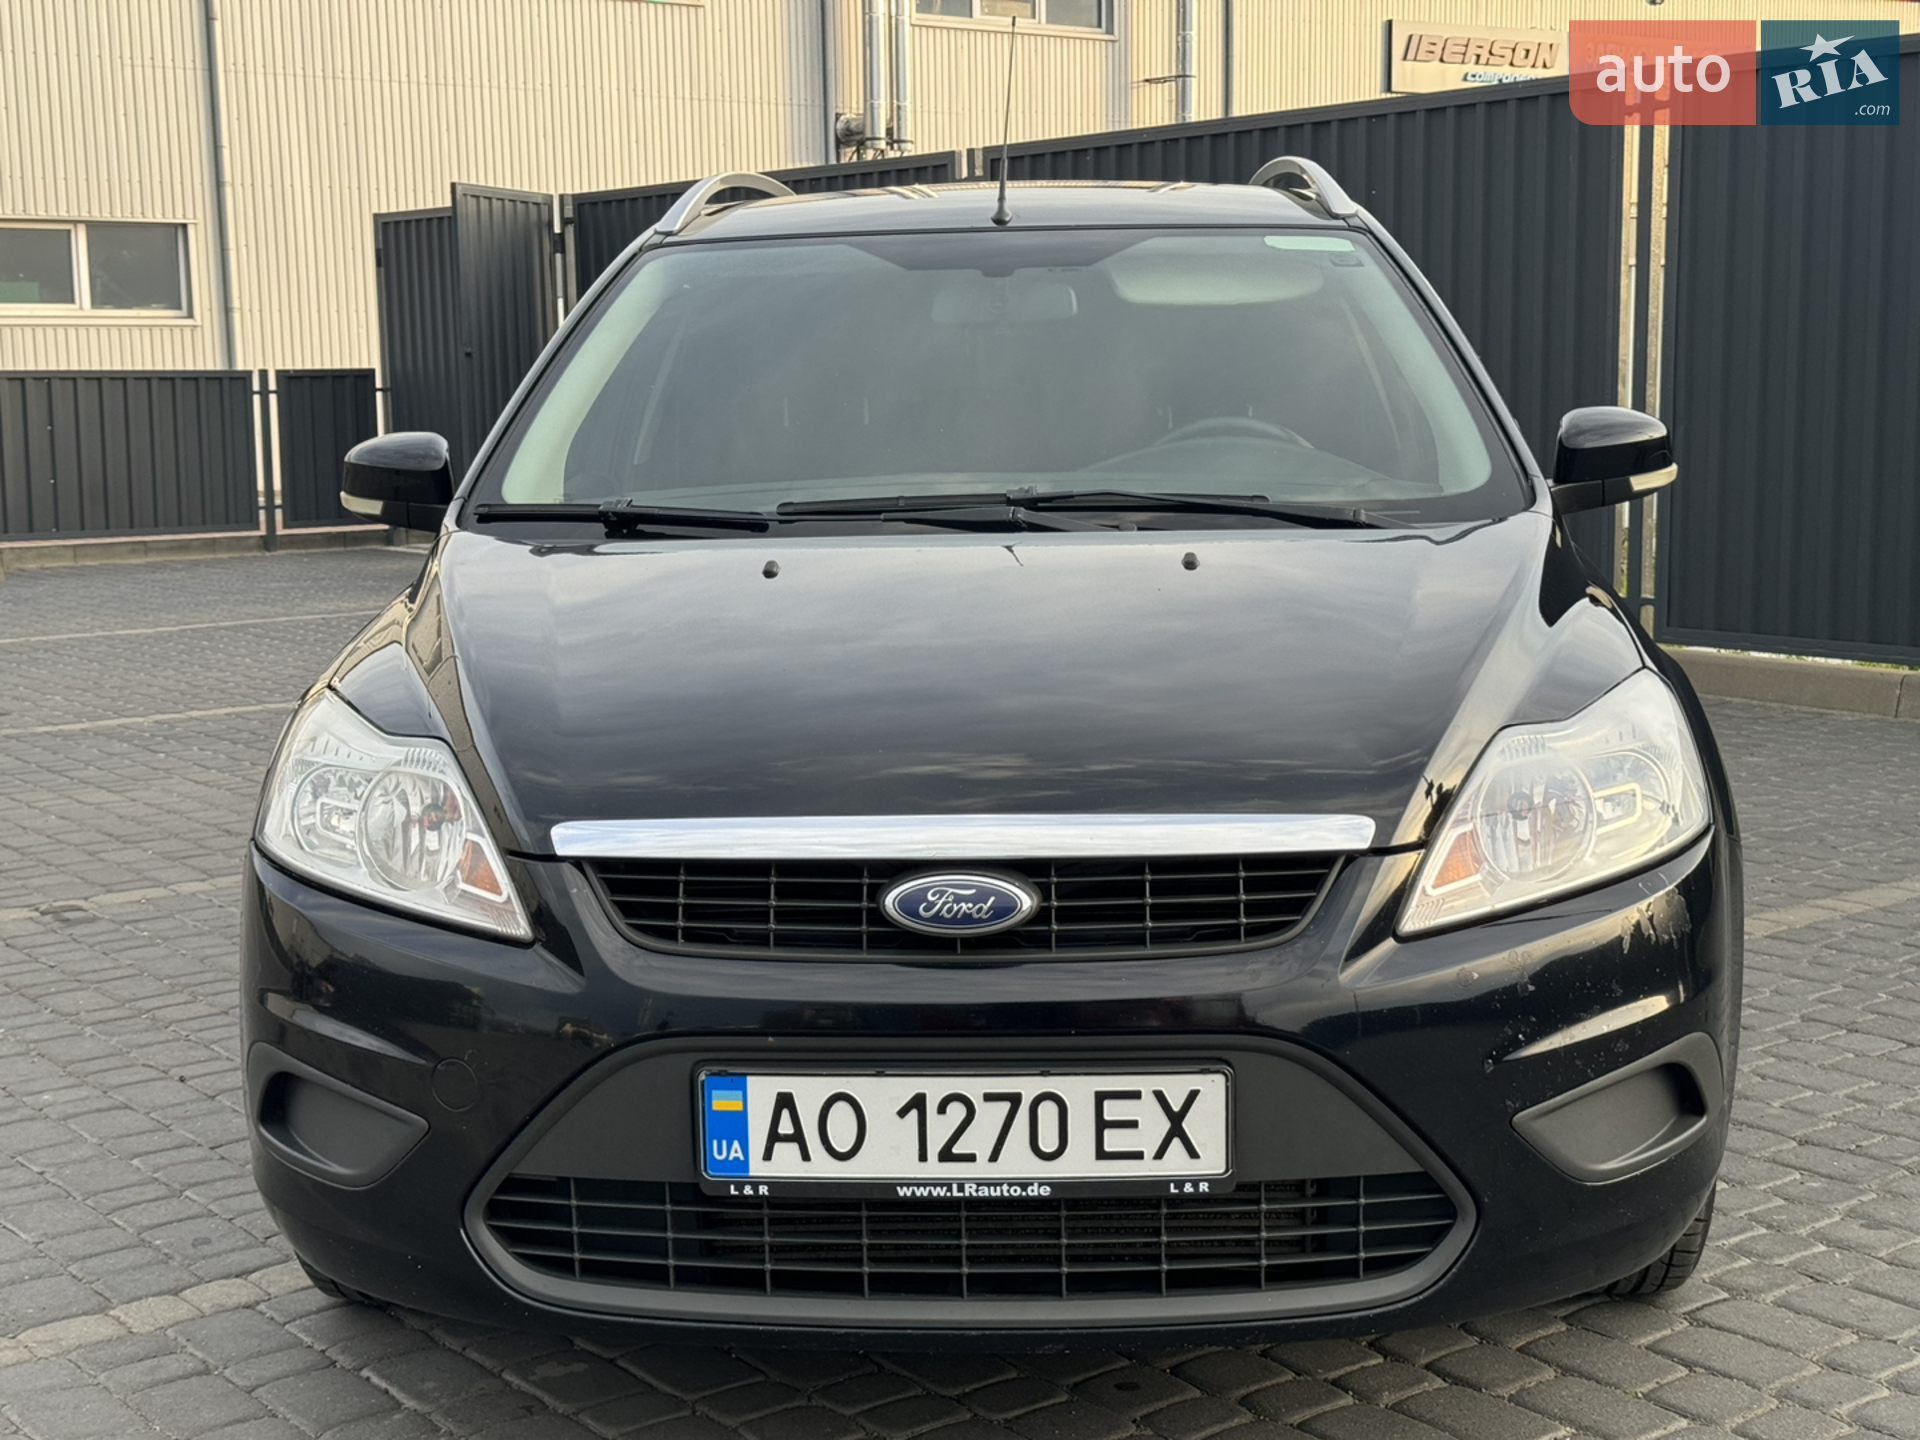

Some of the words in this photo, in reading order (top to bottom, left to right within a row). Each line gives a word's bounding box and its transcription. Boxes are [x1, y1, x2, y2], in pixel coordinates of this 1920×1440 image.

[1403, 33, 1560, 70] IBERSON
[918, 887, 996, 919] Ford
[762, 1091, 867, 1162] AO
[896, 1090, 1068, 1163] 1270
[1094, 1089, 1201, 1161] EX
[712, 1139, 745, 1161] UA
[896, 1182, 1051, 1197] www.LRauto.de
